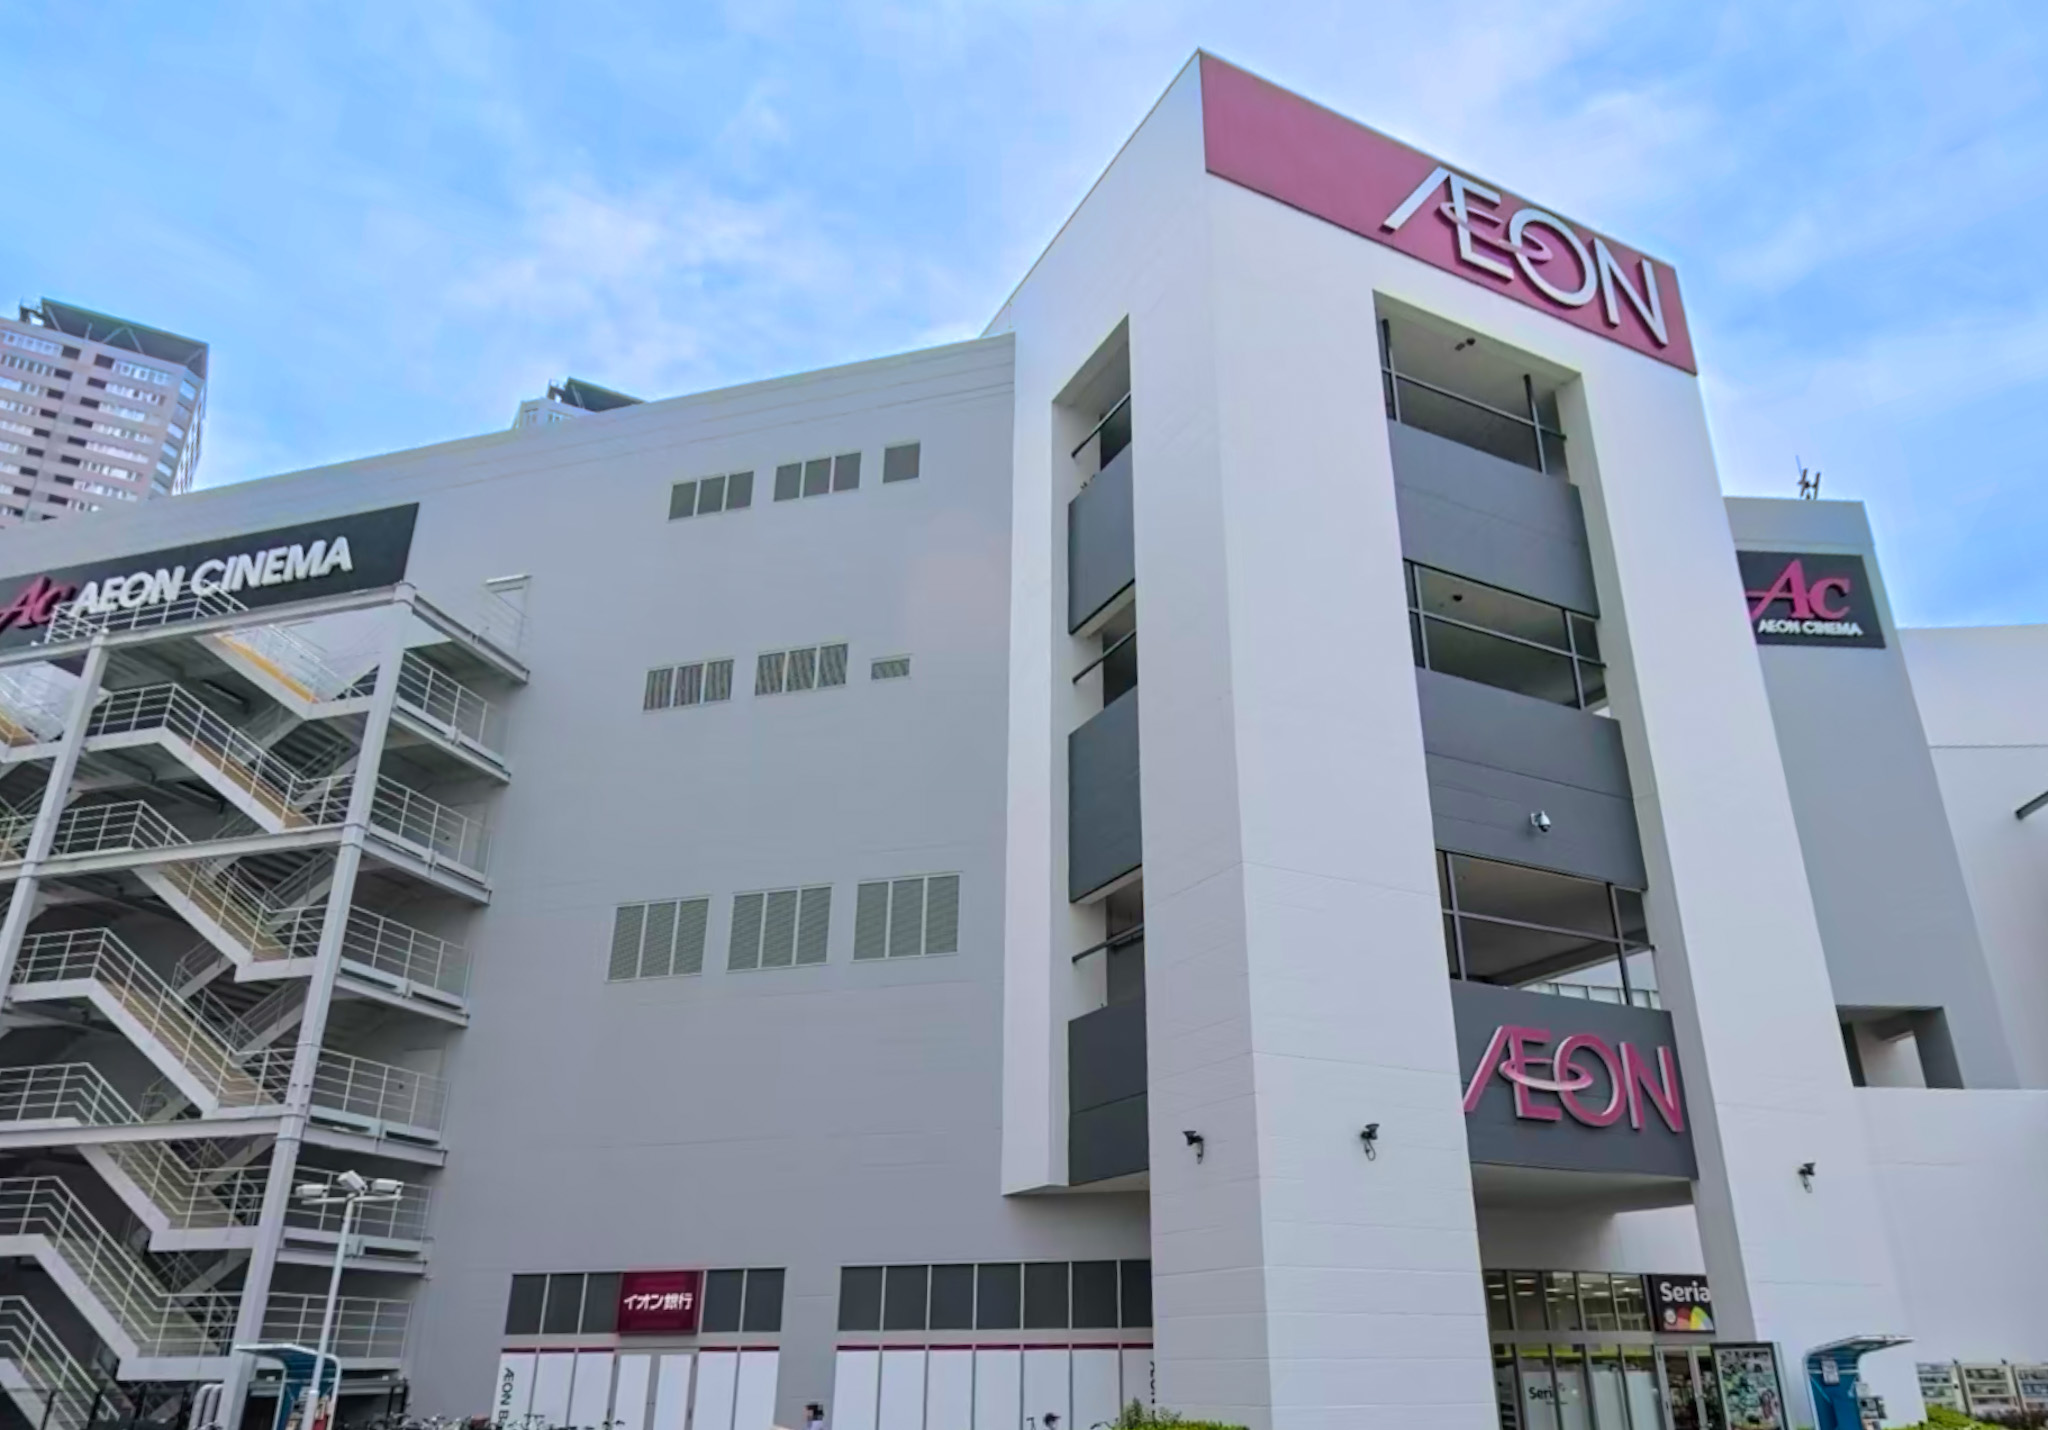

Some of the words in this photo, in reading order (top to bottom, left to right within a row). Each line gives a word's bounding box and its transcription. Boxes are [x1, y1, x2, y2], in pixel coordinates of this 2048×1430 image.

[67, 565, 186, 618] AEON
[190, 536, 353, 595] CINEMA
[1758, 619, 1800, 635] AEON
[1802, 621, 1864, 637] CINEMA
[1660, 1280, 1711, 1302] Seria
[624, 1292, 693, 1311] イオン銀行
